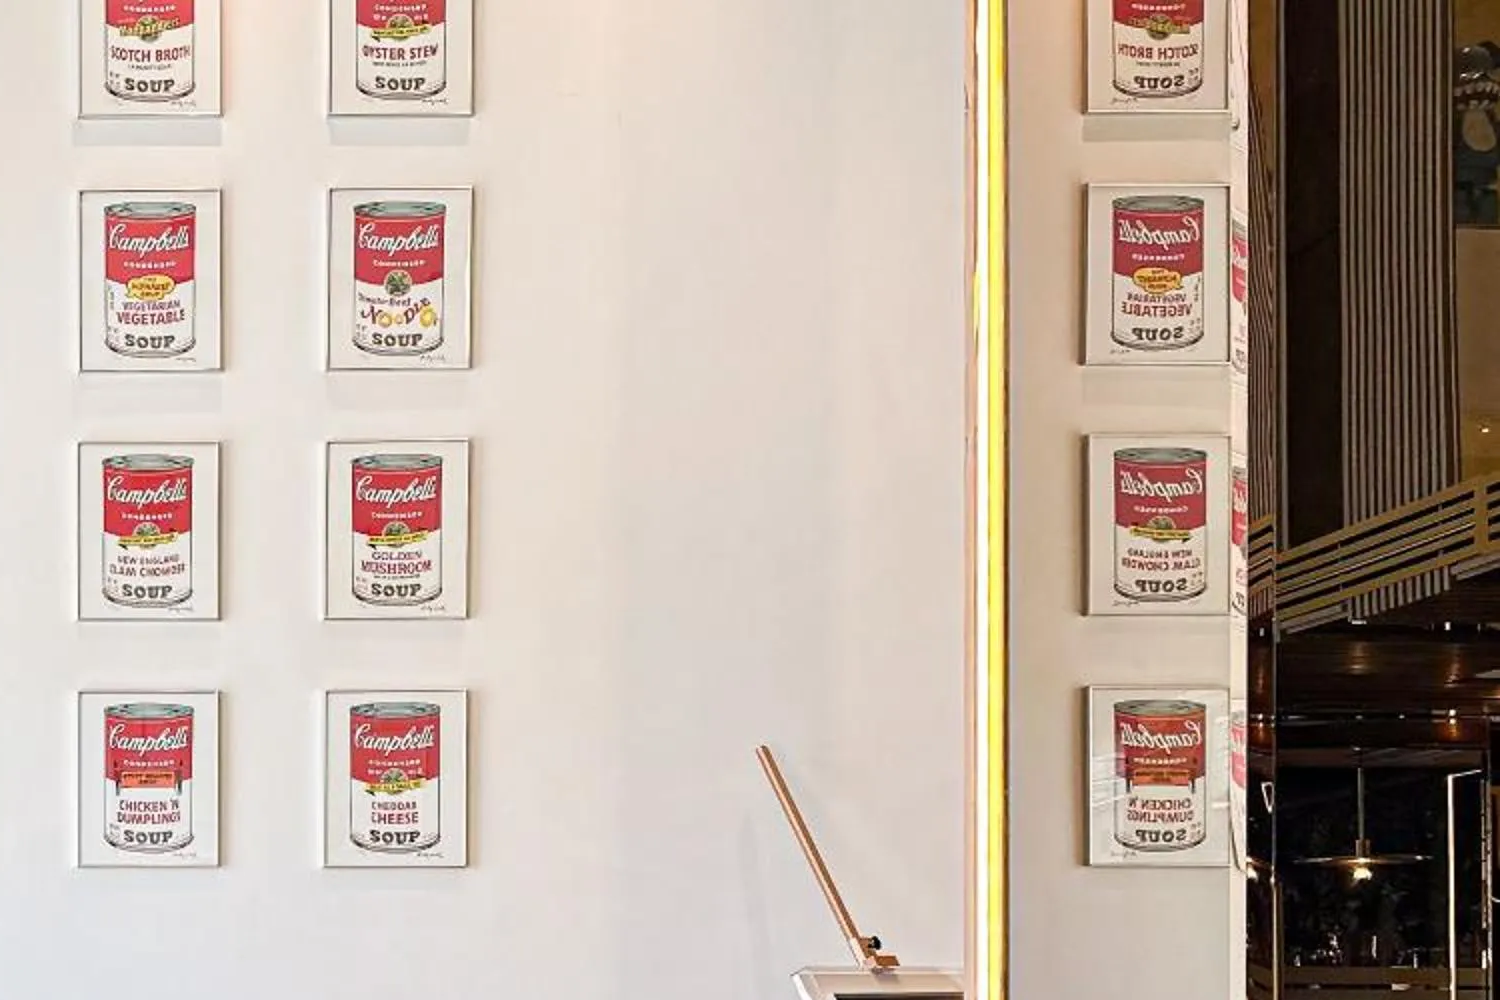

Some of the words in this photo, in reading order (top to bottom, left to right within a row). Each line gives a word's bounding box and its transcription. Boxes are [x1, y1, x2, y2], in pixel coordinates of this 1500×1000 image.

[111, 46, 150, 63] SCOTCH
[155, 46, 191, 62] BROTH
[362, 45, 405, 61] OYSTER
[409, 44, 438, 60] STEW
[124, 77, 175, 93] SOUP
[375, 76, 426, 92] SOUP
[116, 309, 185, 325] VEGETABLE
[124, 334, 176, 349] SOUP
[372, 332, 423, 347] SOUP
[122, 583, 173, 599] SOUP
[371, 583, 422, 597] SOUP
[119, 799, 167, 813] CHICKEN
[371, 801, 417, 810] CHEDDAR
[117, 811, 181, 825] DUMPLINGS
[371, 811, 419, 824] CHEESE
[123, 829, 174, 845] SOUP
[369, 829, 421, 845] SOUP
